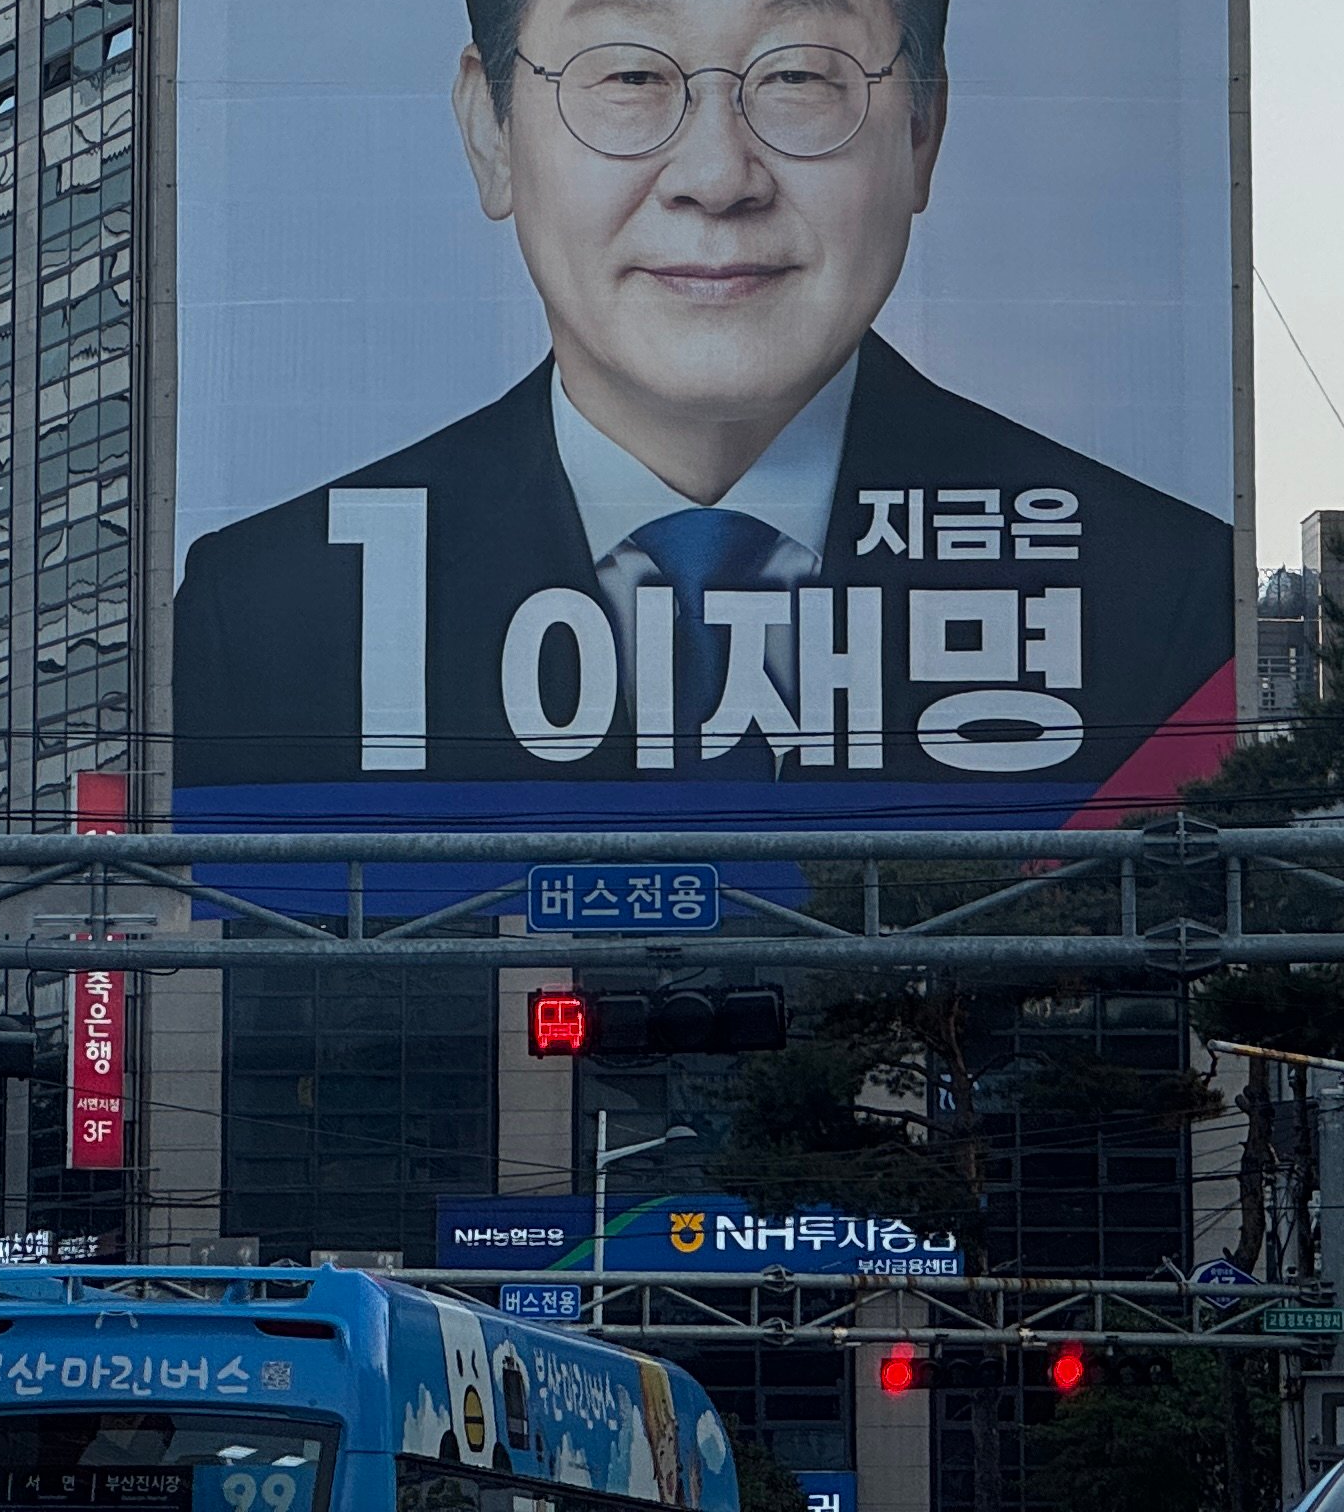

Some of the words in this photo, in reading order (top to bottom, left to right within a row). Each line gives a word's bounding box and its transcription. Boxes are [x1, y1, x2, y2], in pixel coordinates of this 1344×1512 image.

[855, 487, 1083, 562] 지금은
[326, 487, 428, 772] 1
[501, 584, 1085, 773] 이재명
[540, 867, 708, 921] 버스전용
[83, 1119, 113, 1142] 3F
[858, 1258, 958, 1276] 부산금융센터
[505, 1290, 577, 1315] 버스전용
